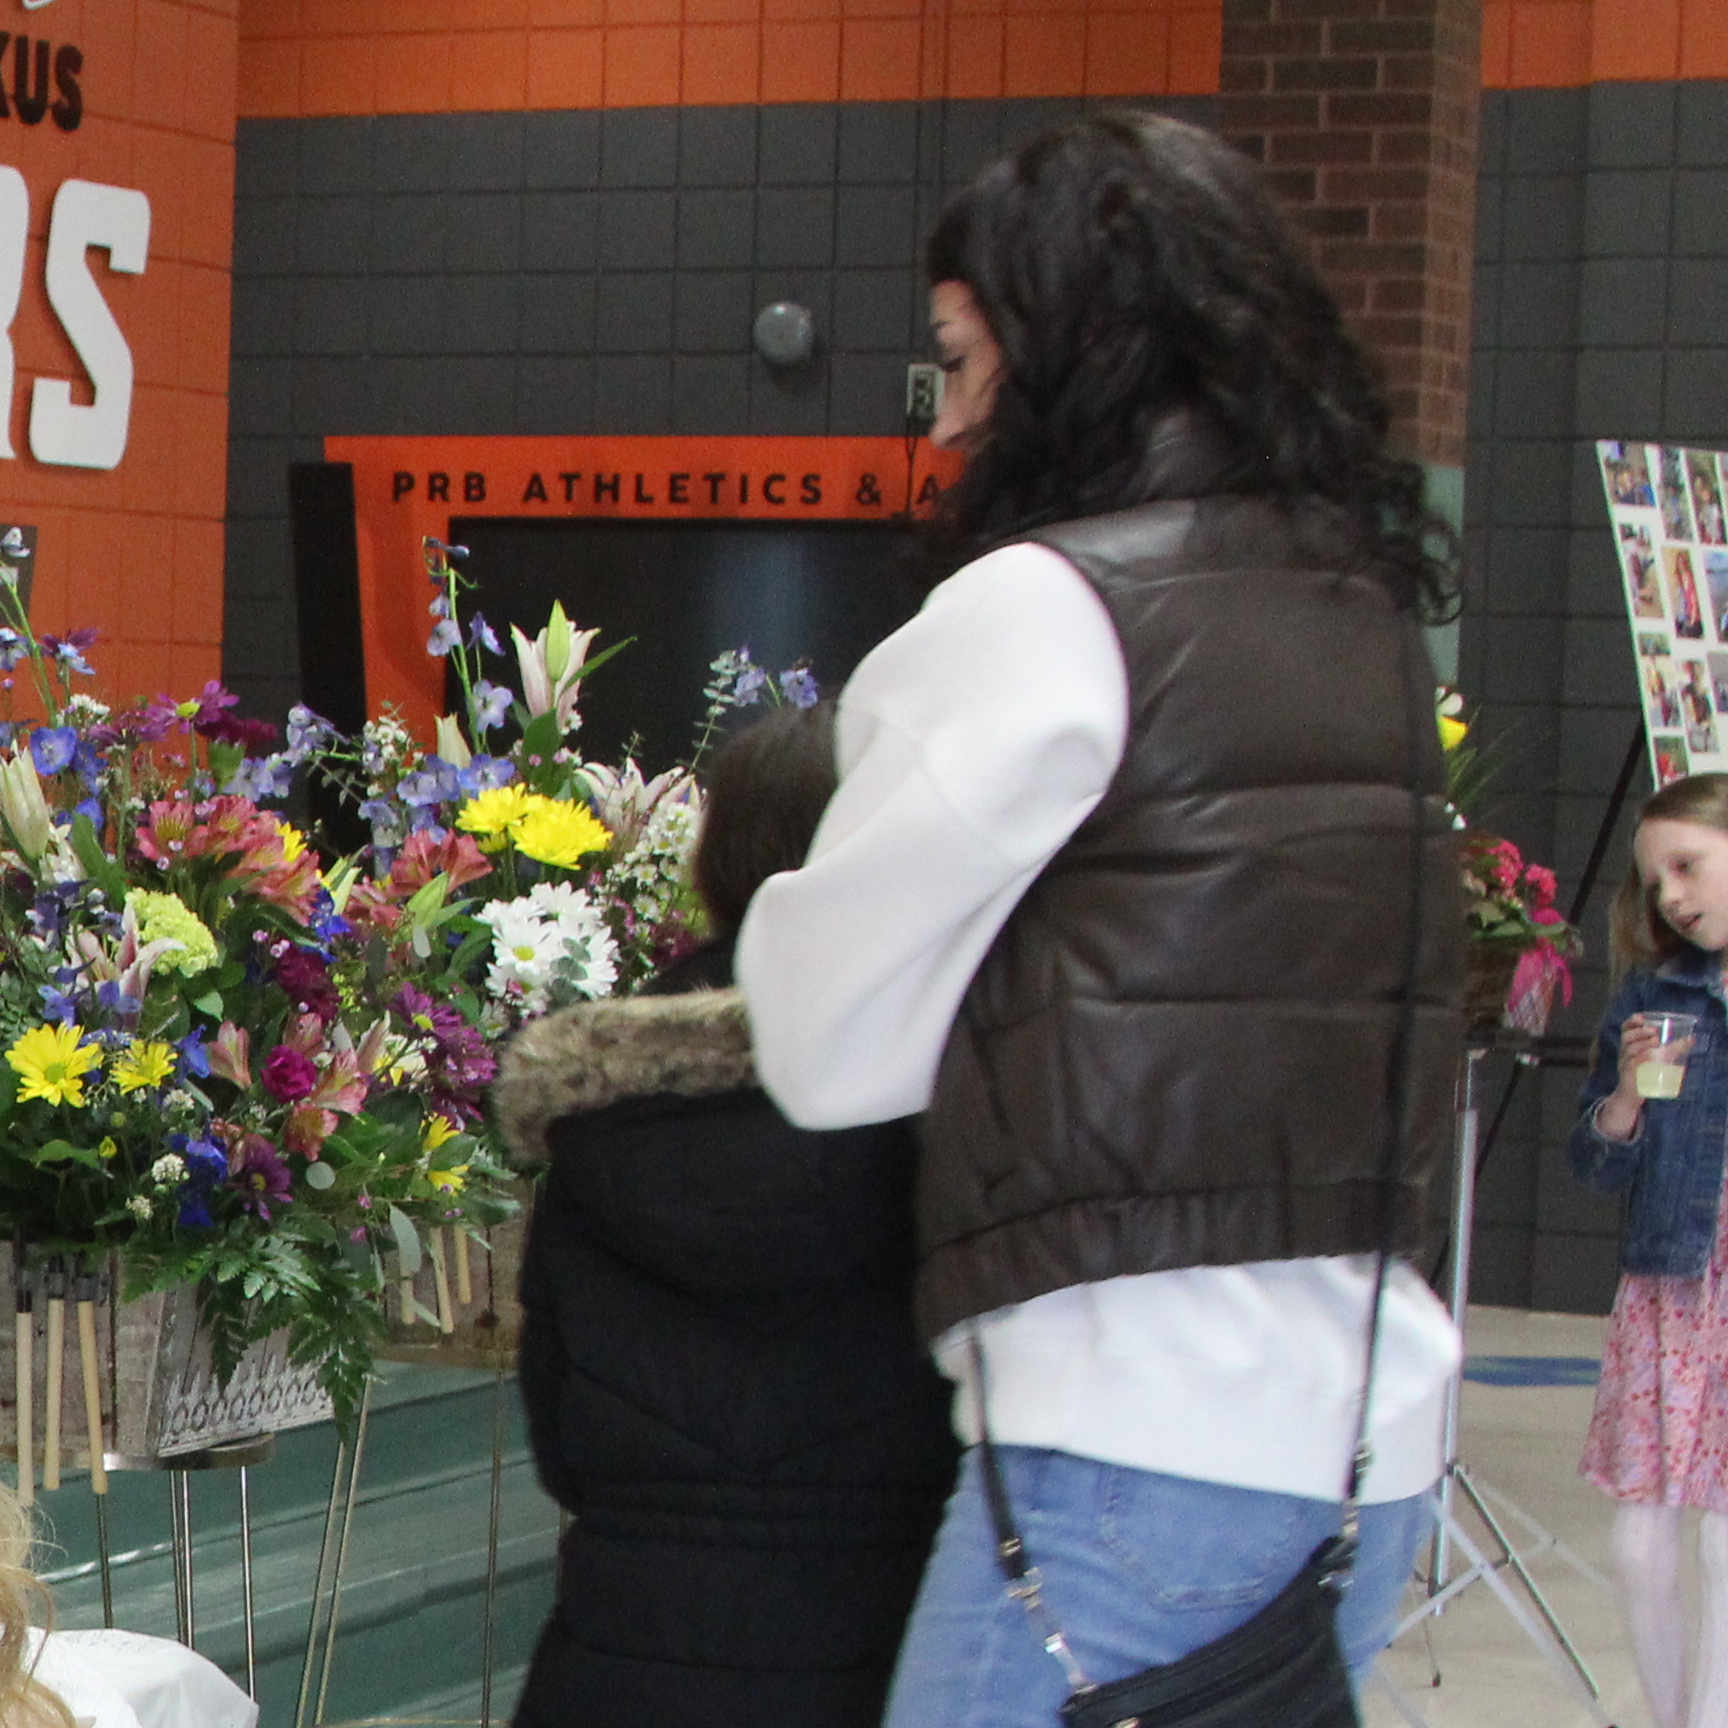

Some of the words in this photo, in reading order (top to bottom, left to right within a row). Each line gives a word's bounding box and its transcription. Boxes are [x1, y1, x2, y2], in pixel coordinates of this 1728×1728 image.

[392, 472, 488, 503] PRB
[522, 473, 823, 504] ATHLETICS
[855, 473, 882, 504] &
